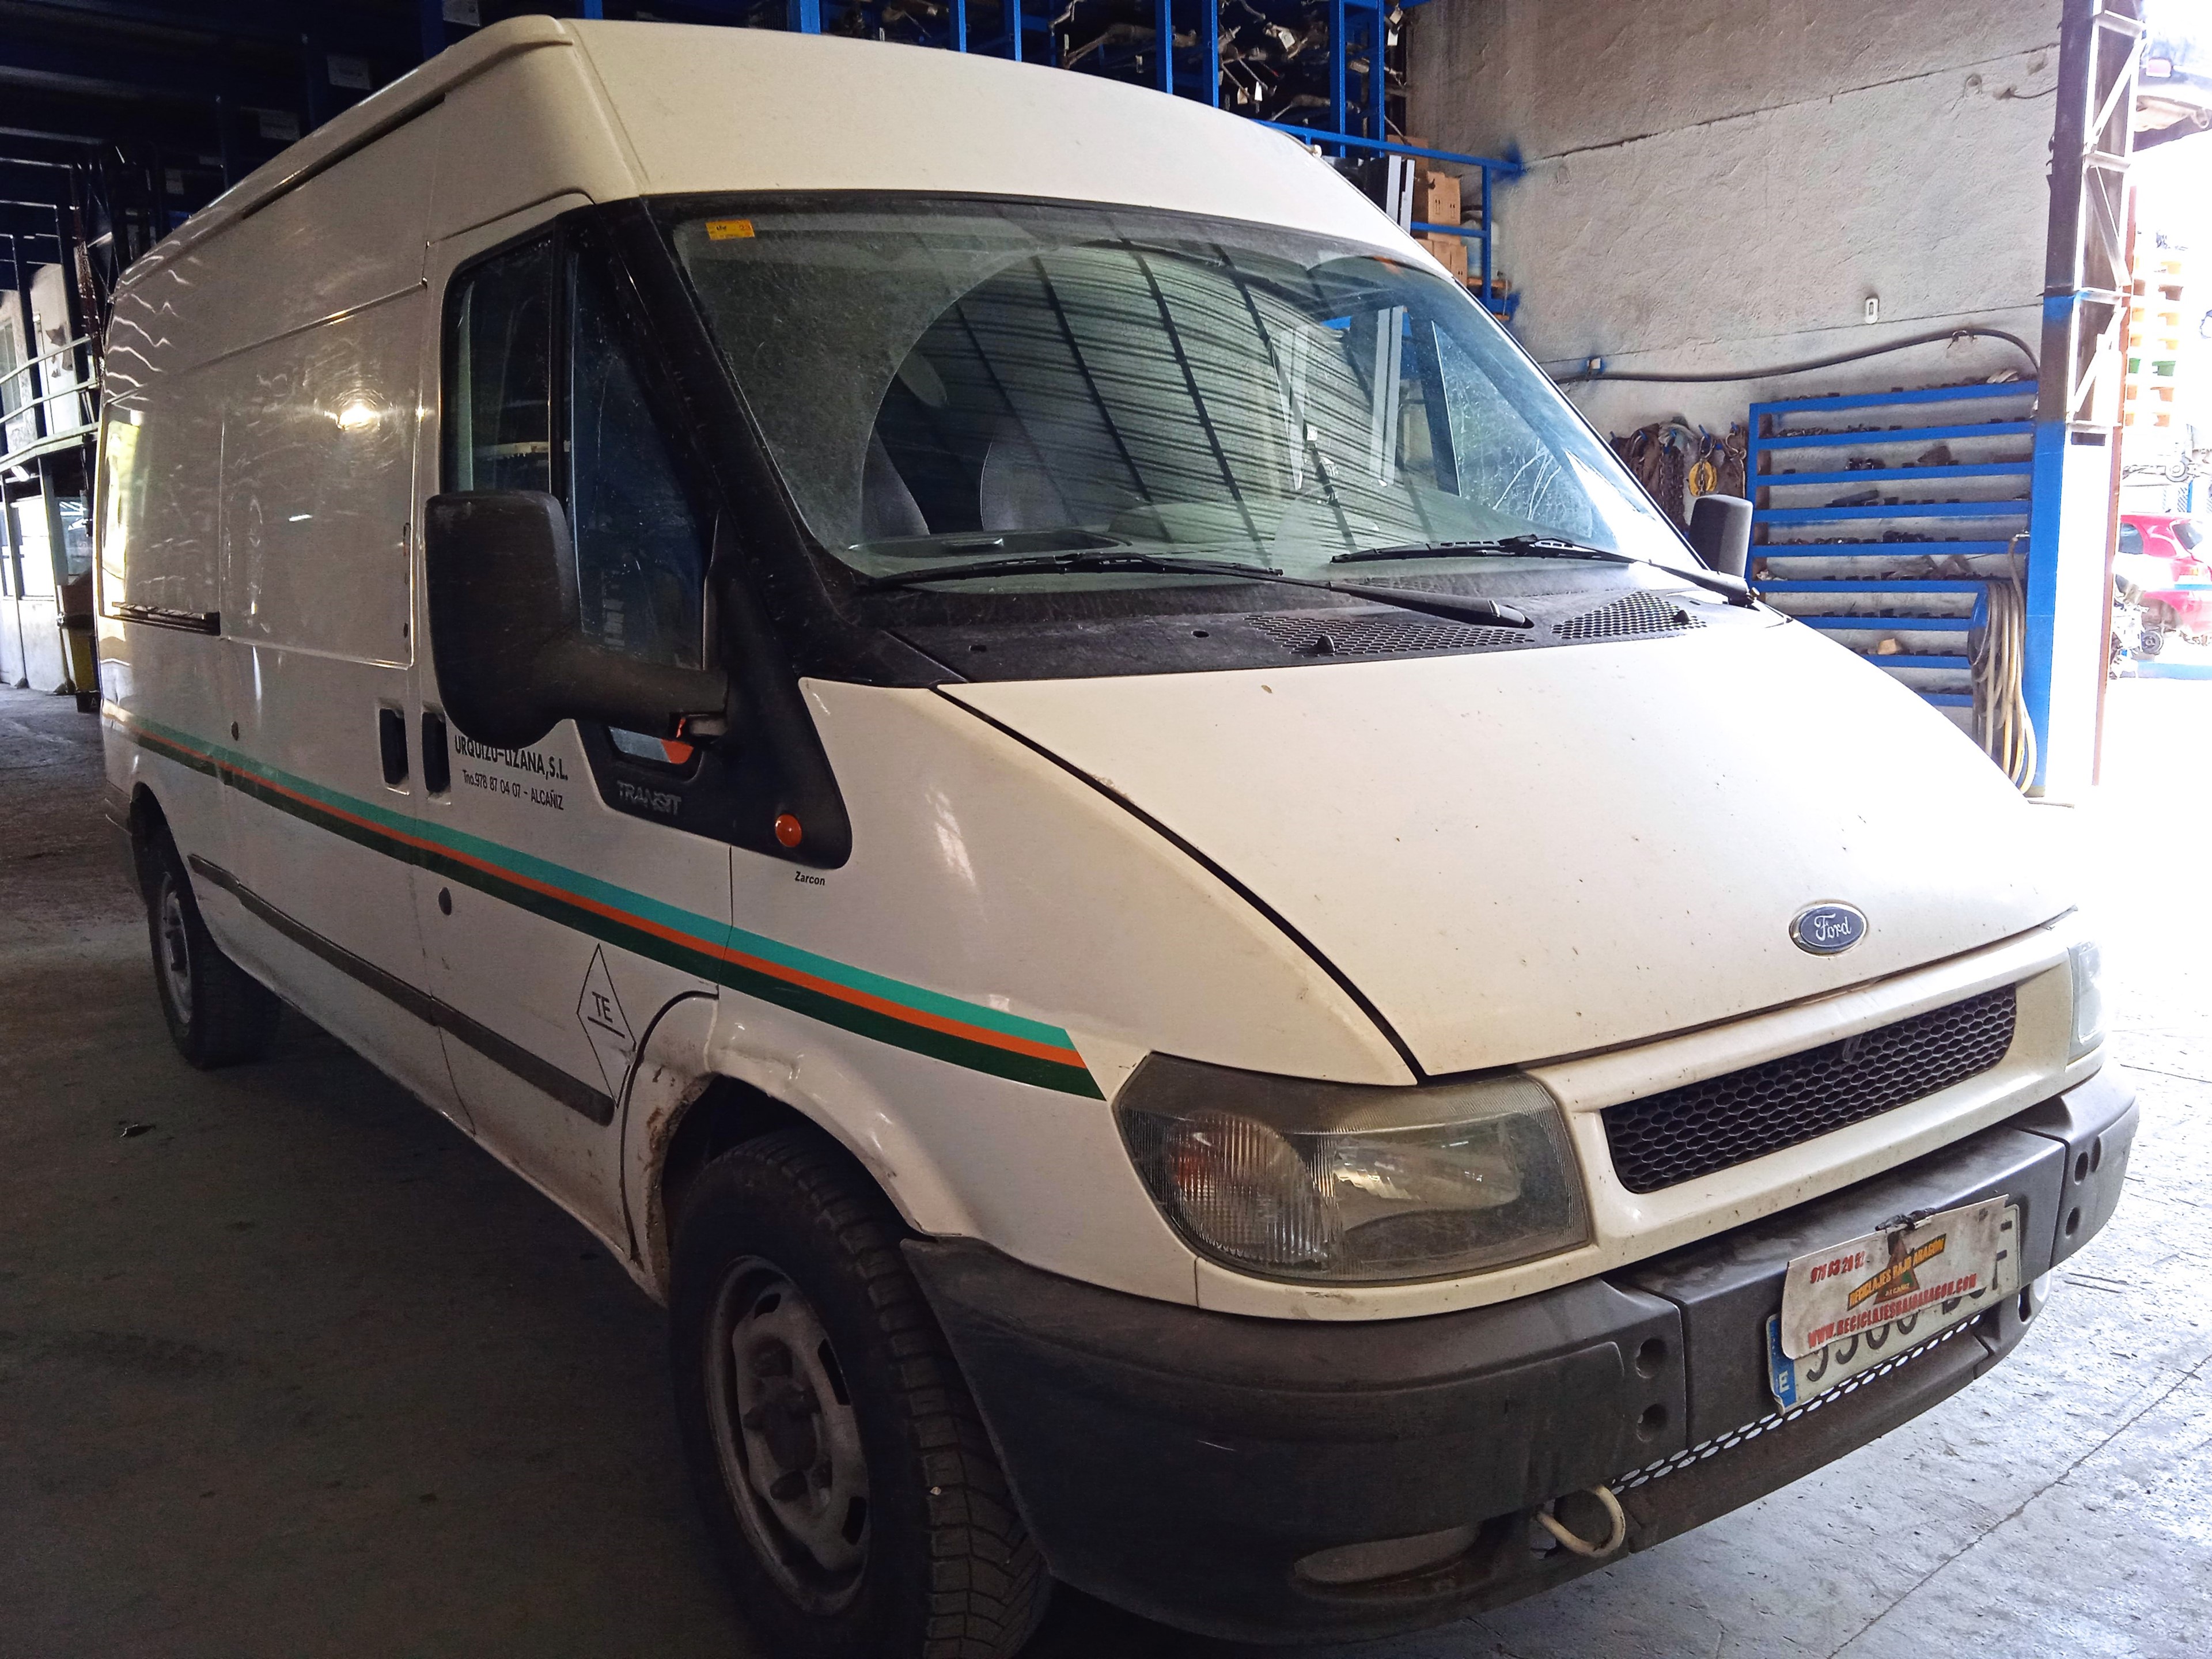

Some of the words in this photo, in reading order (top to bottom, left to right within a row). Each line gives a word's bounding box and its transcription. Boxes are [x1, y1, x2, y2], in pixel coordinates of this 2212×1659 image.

[490, 777, 497, 791] 87
[501, 780, 510, 794] 04
[513, 783, 521, 798] 07
[531, 787, 563, 810] ALCAÑIZ
[617, 779, 681, 816] TRANSIT
[795, 871, 825, 886] Zarcon
[1814, 913, 1851, 941] Ford
[592, 991, 613, 1023] TE
[1779, 1370, 1790, 1393] E
